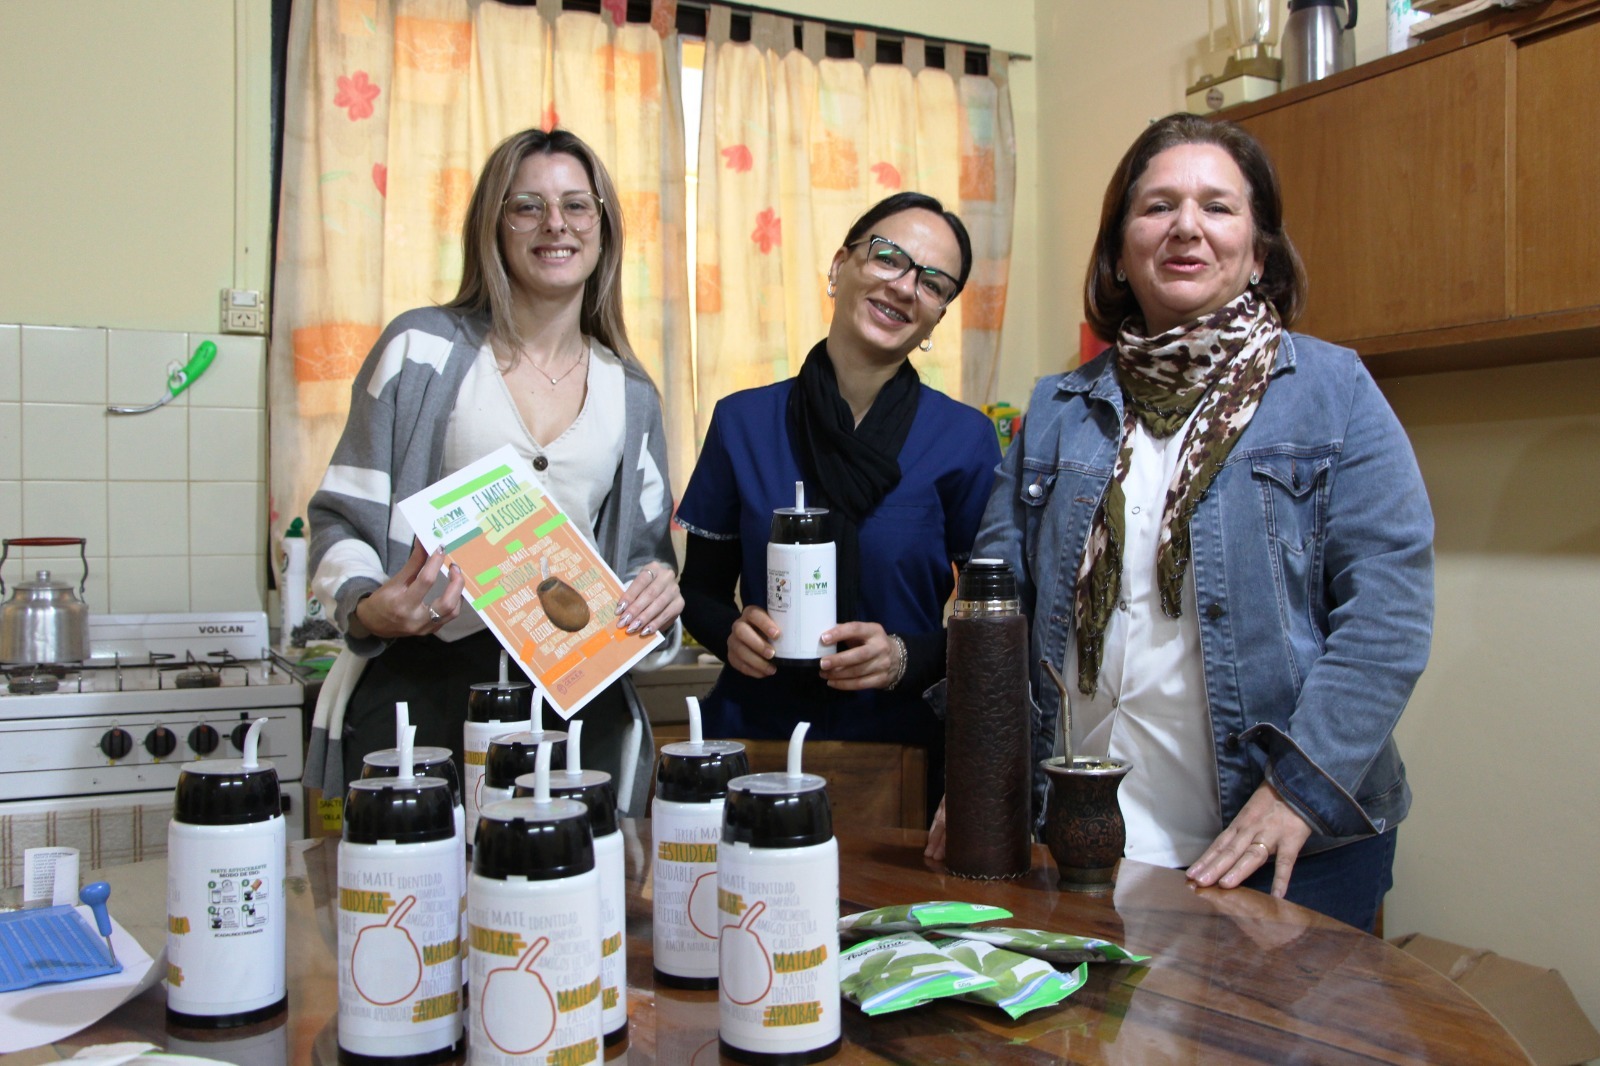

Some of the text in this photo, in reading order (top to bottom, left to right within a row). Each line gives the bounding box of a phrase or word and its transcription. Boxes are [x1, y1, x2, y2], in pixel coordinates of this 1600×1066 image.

[472, 475, 522, 513] EL MATE EN
[436, 506, 465, 527] INYM
[486, 512, 504, 533] LA
[497, 494, 537, 526] ESCUELA
[509, 546, 530, 564] MATE
[497, 560, 538, 593] ESTUDIAR
[805, 582, 828, 590] INYM
[499, 585, 537, 615] SALUDABLE
[199, 626, 244, 634] VOLCAN
[363, 872, 394, 887] MATE
[398, 872, 442, 889] IDENTIDAD
[748, 881, 796, 895] IDENTIDAD
[491, 910, 525, 927] MATE
[529, 911, 578, 930] IDENTIDAD
[755, 919, 818, 937] AMIGOS LECTURA
[665, 940, 685, 952] AMOR
[773, 947, 823, 972] MATEAR
[771, 984, 816, 1004] IDENTIDAD
[767, 1002, 819, 1027] APROBAR
